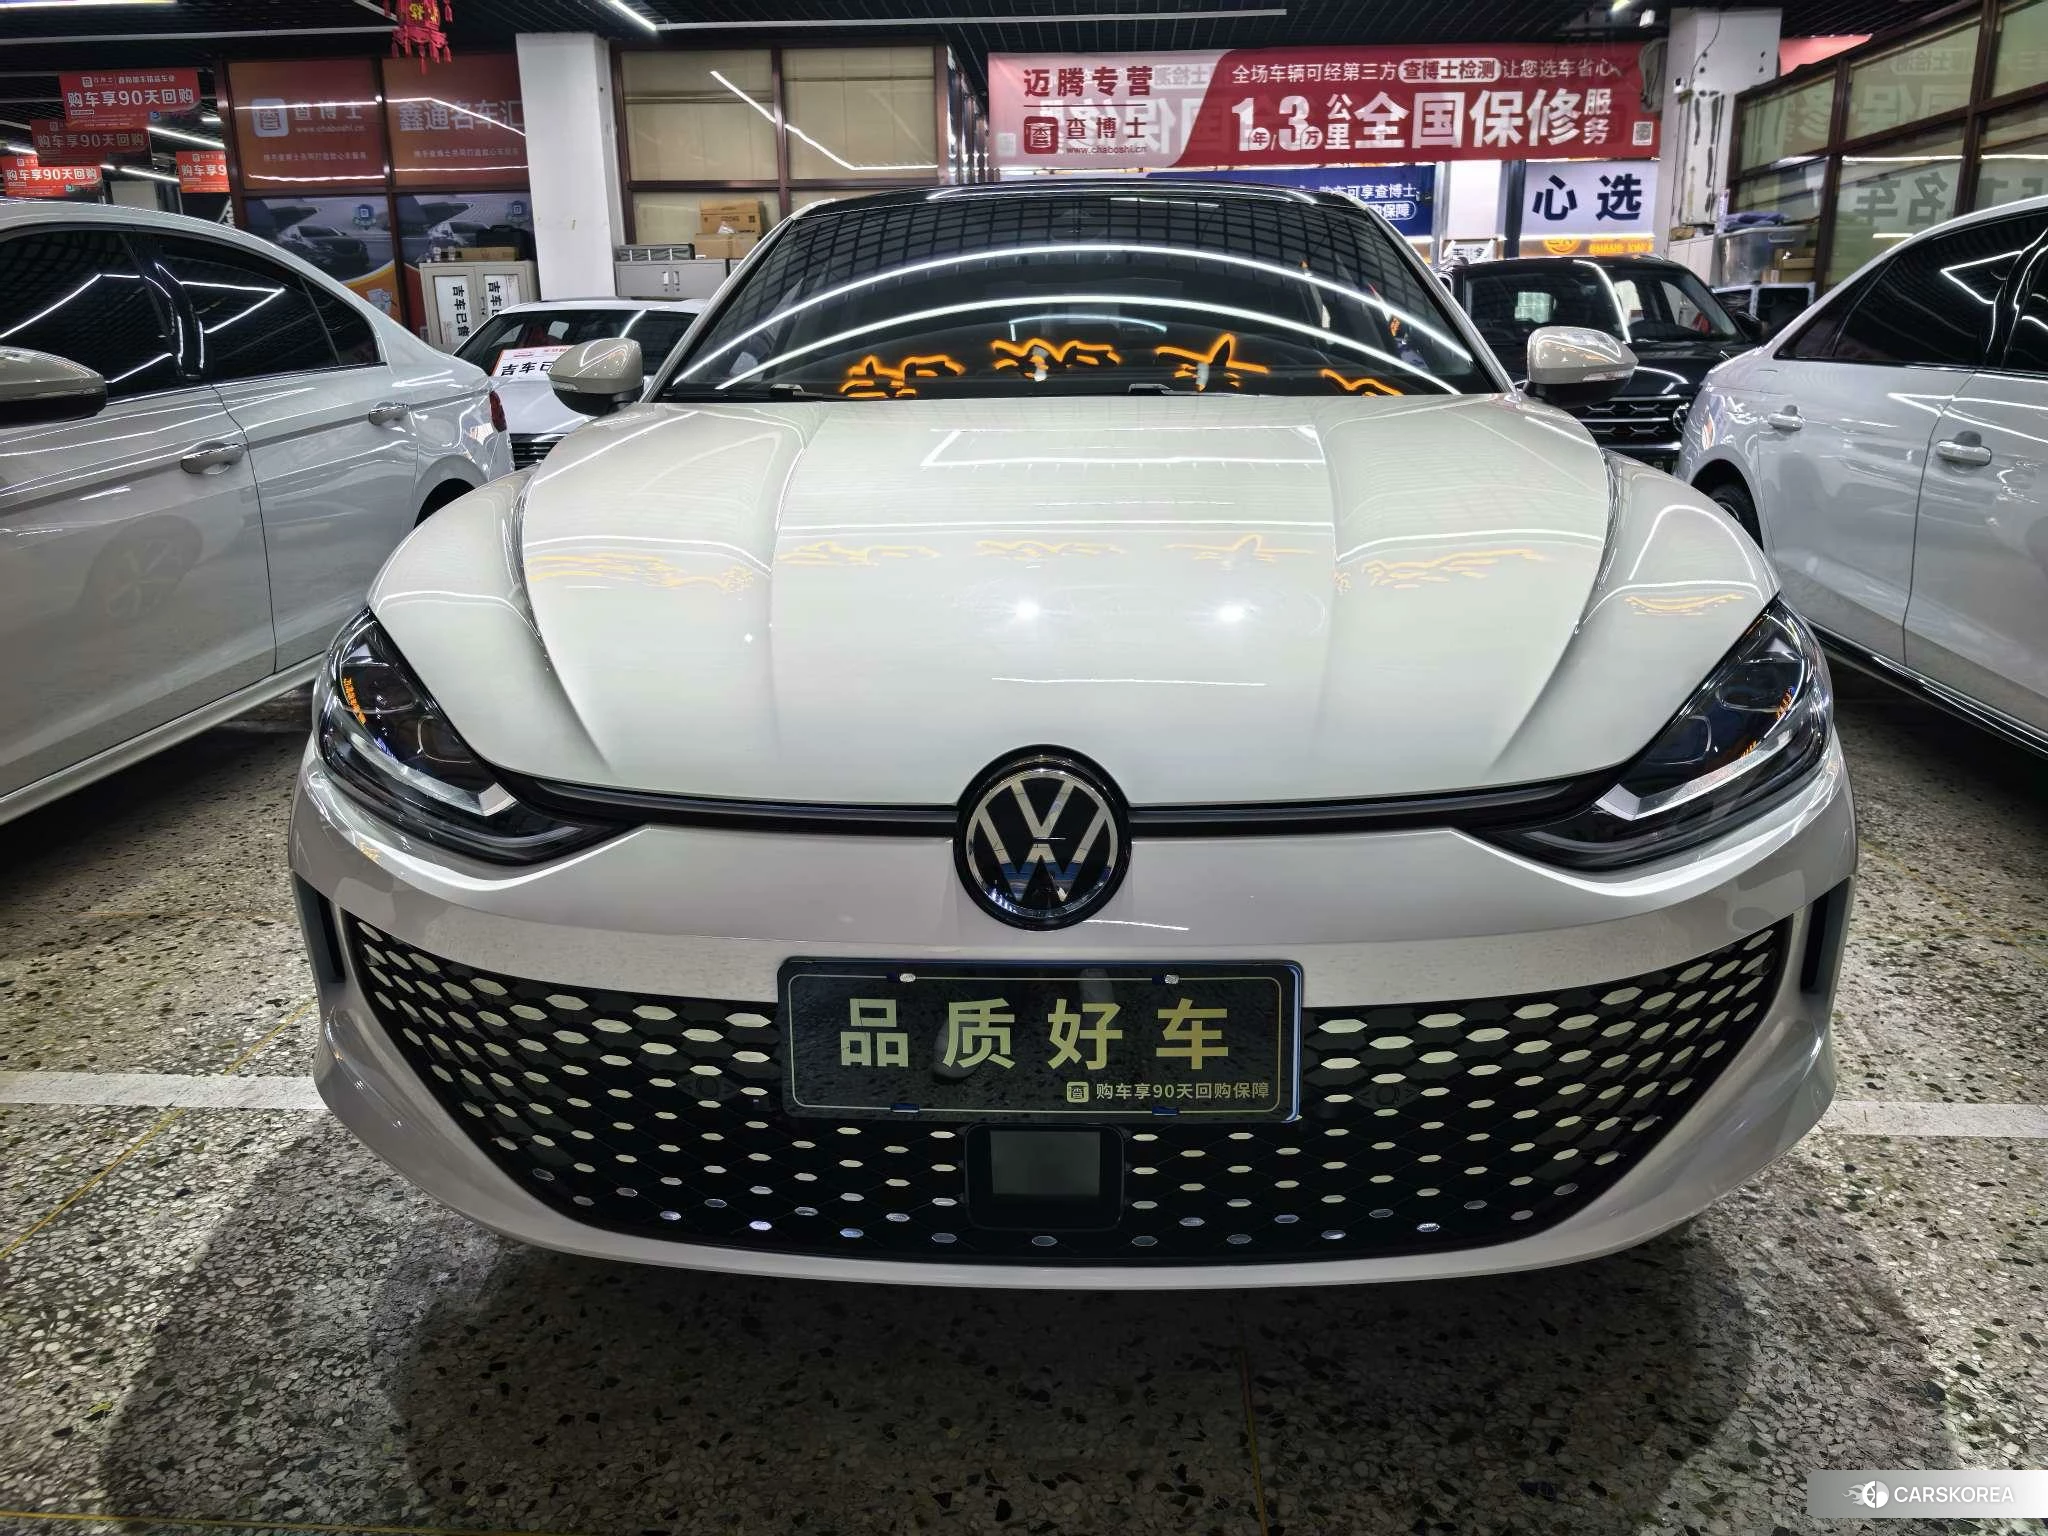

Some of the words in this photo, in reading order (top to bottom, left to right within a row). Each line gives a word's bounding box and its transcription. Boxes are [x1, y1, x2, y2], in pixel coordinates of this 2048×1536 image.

[1024, 66, 1153, 97] 迈腾专营
[67, 88, 194, 107] 购车享90天回购
[1066, 117, 1147, 139] 查博士
[37, 133, 144, 148] 购车享90天回购
[1066, 145, 1147, 154] www.chaboshi.cn
[6, 167, 97, 181] 购车享90天回购
[1532, 173, 1642, 221] 心选
[841, 998, 1230, 1070] 品质好车
[1096, 1082, 1270, 1100] 购车享90天回购保障
